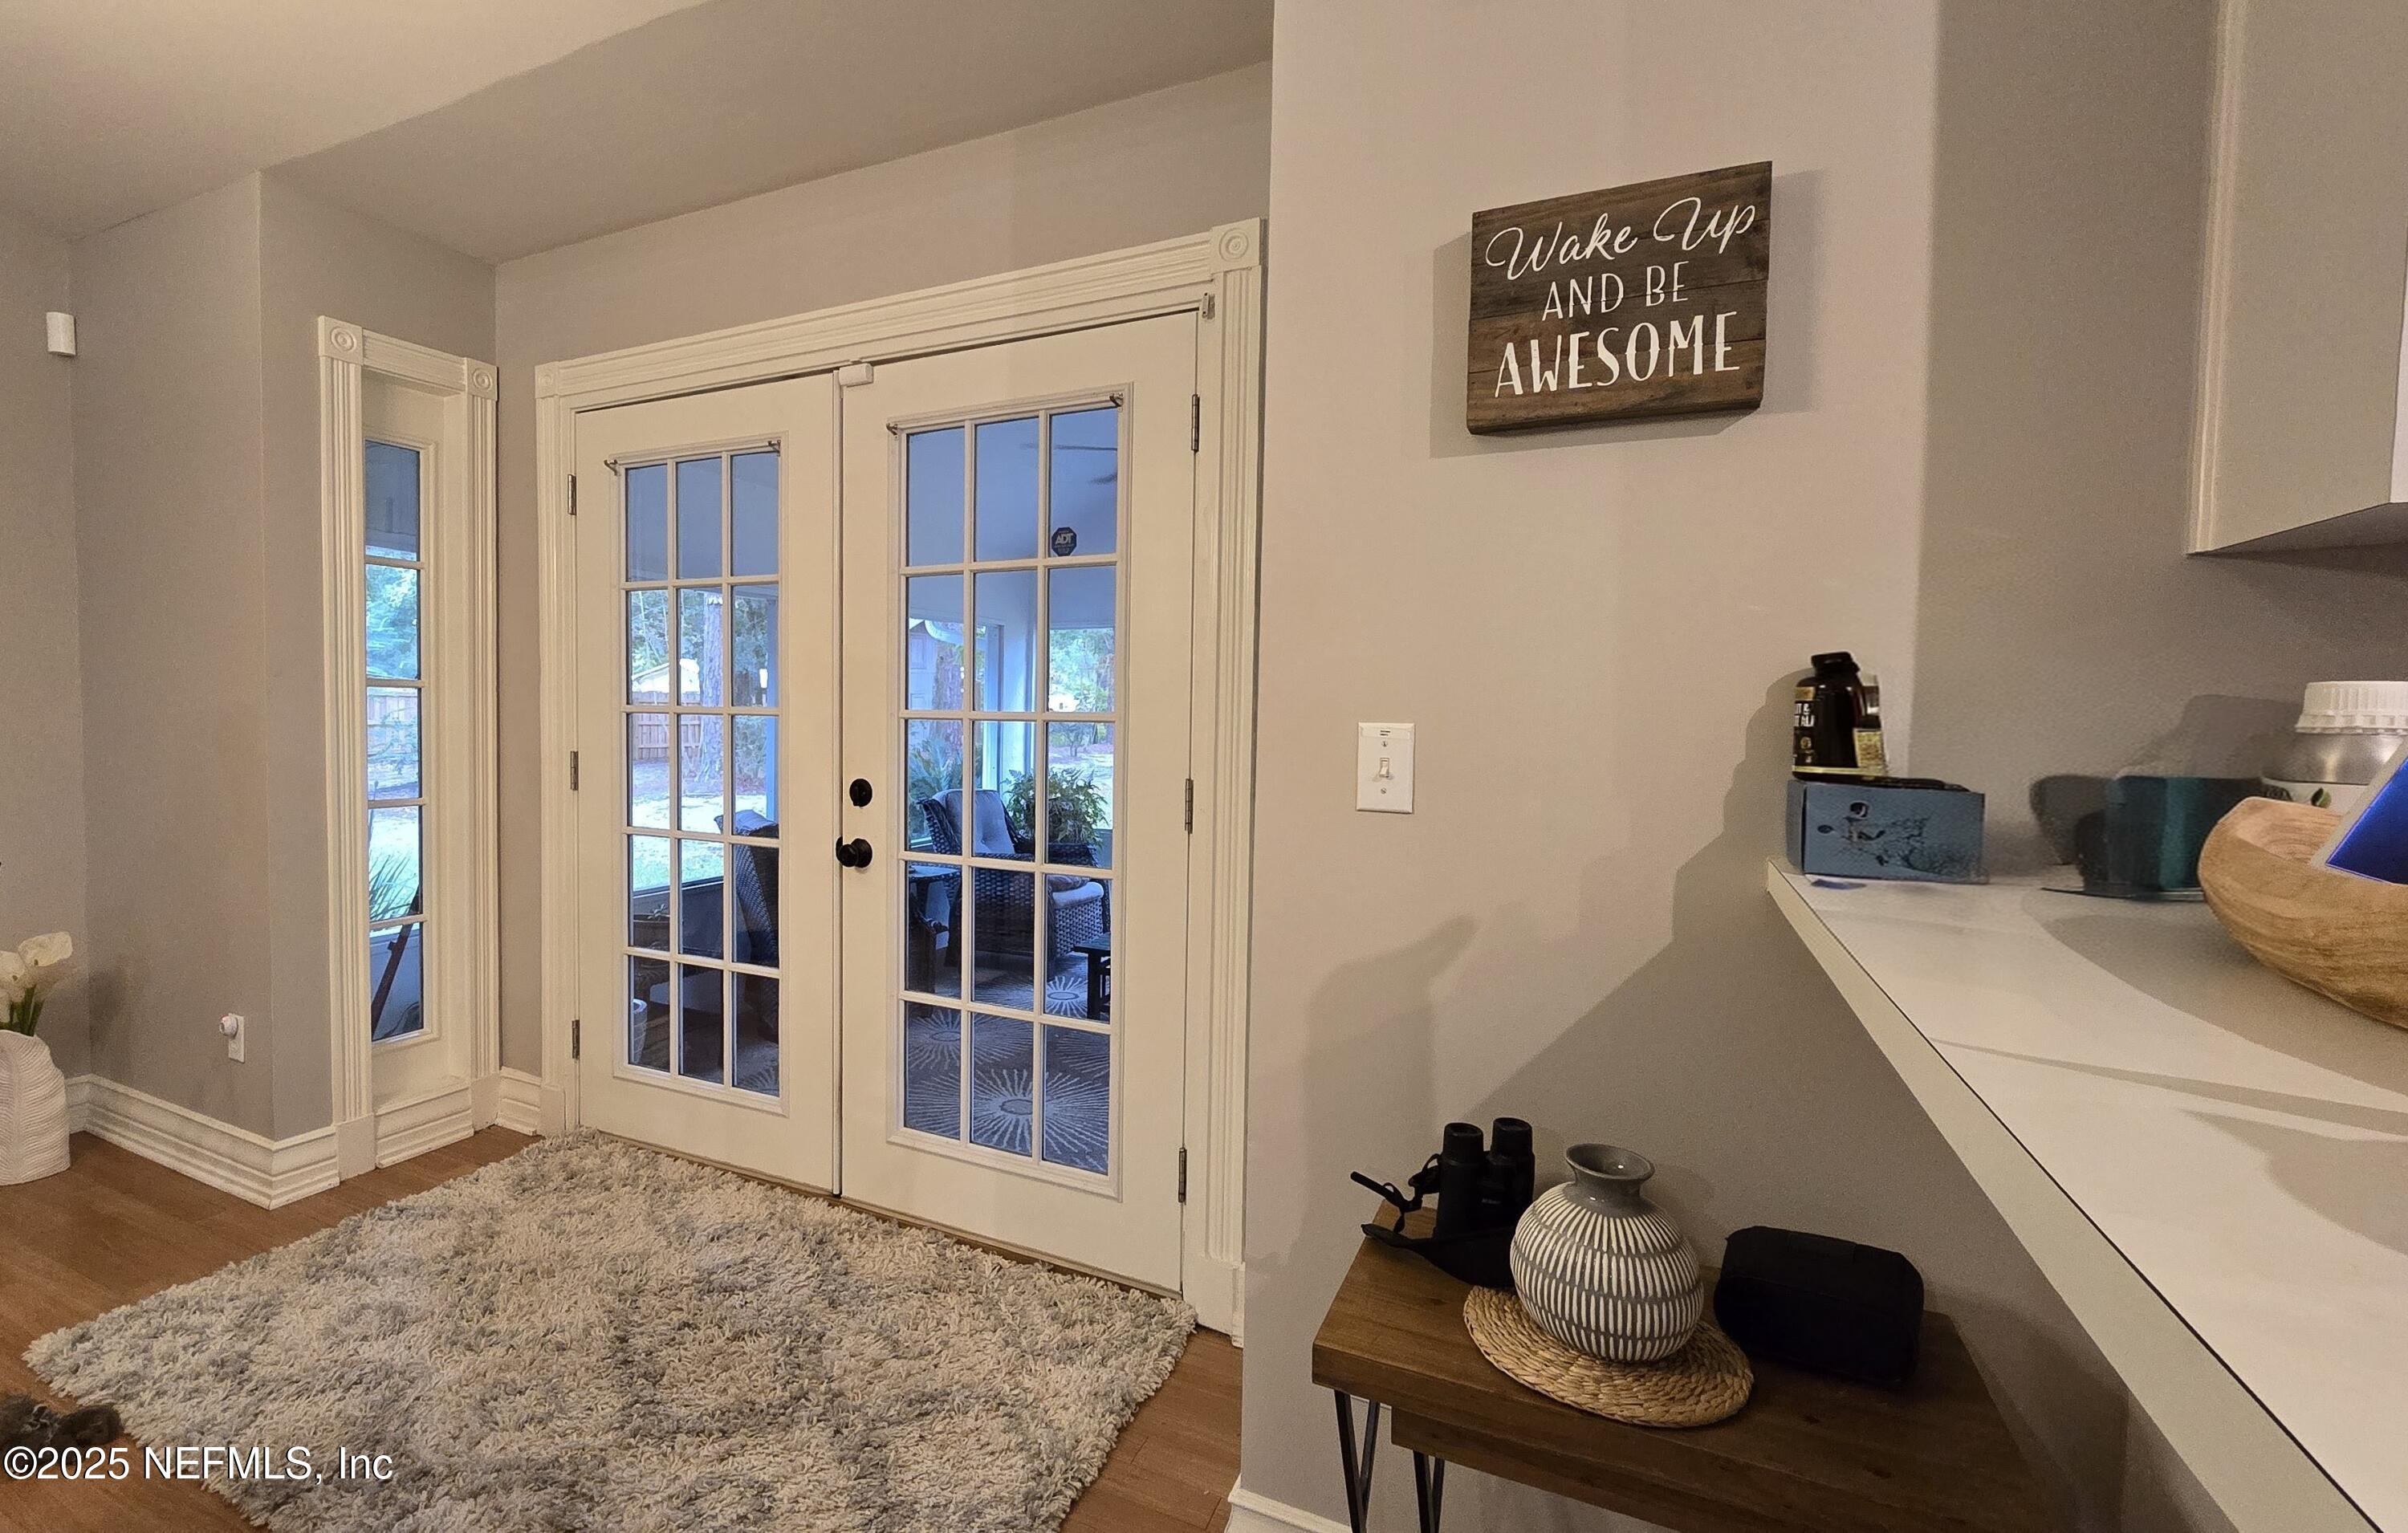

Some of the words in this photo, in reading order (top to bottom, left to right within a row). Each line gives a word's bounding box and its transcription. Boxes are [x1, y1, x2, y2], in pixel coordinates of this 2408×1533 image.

[1485, 212, 1638, 281] Wake
[1653, 197, 1756, 254] Up
[1541, 273, 1624, 321] AND
[1645, 261, 1690, 307] BE
[1495, 311, 1740, 398] AWESOME
[1055, 532, 1074, 545] ADT
